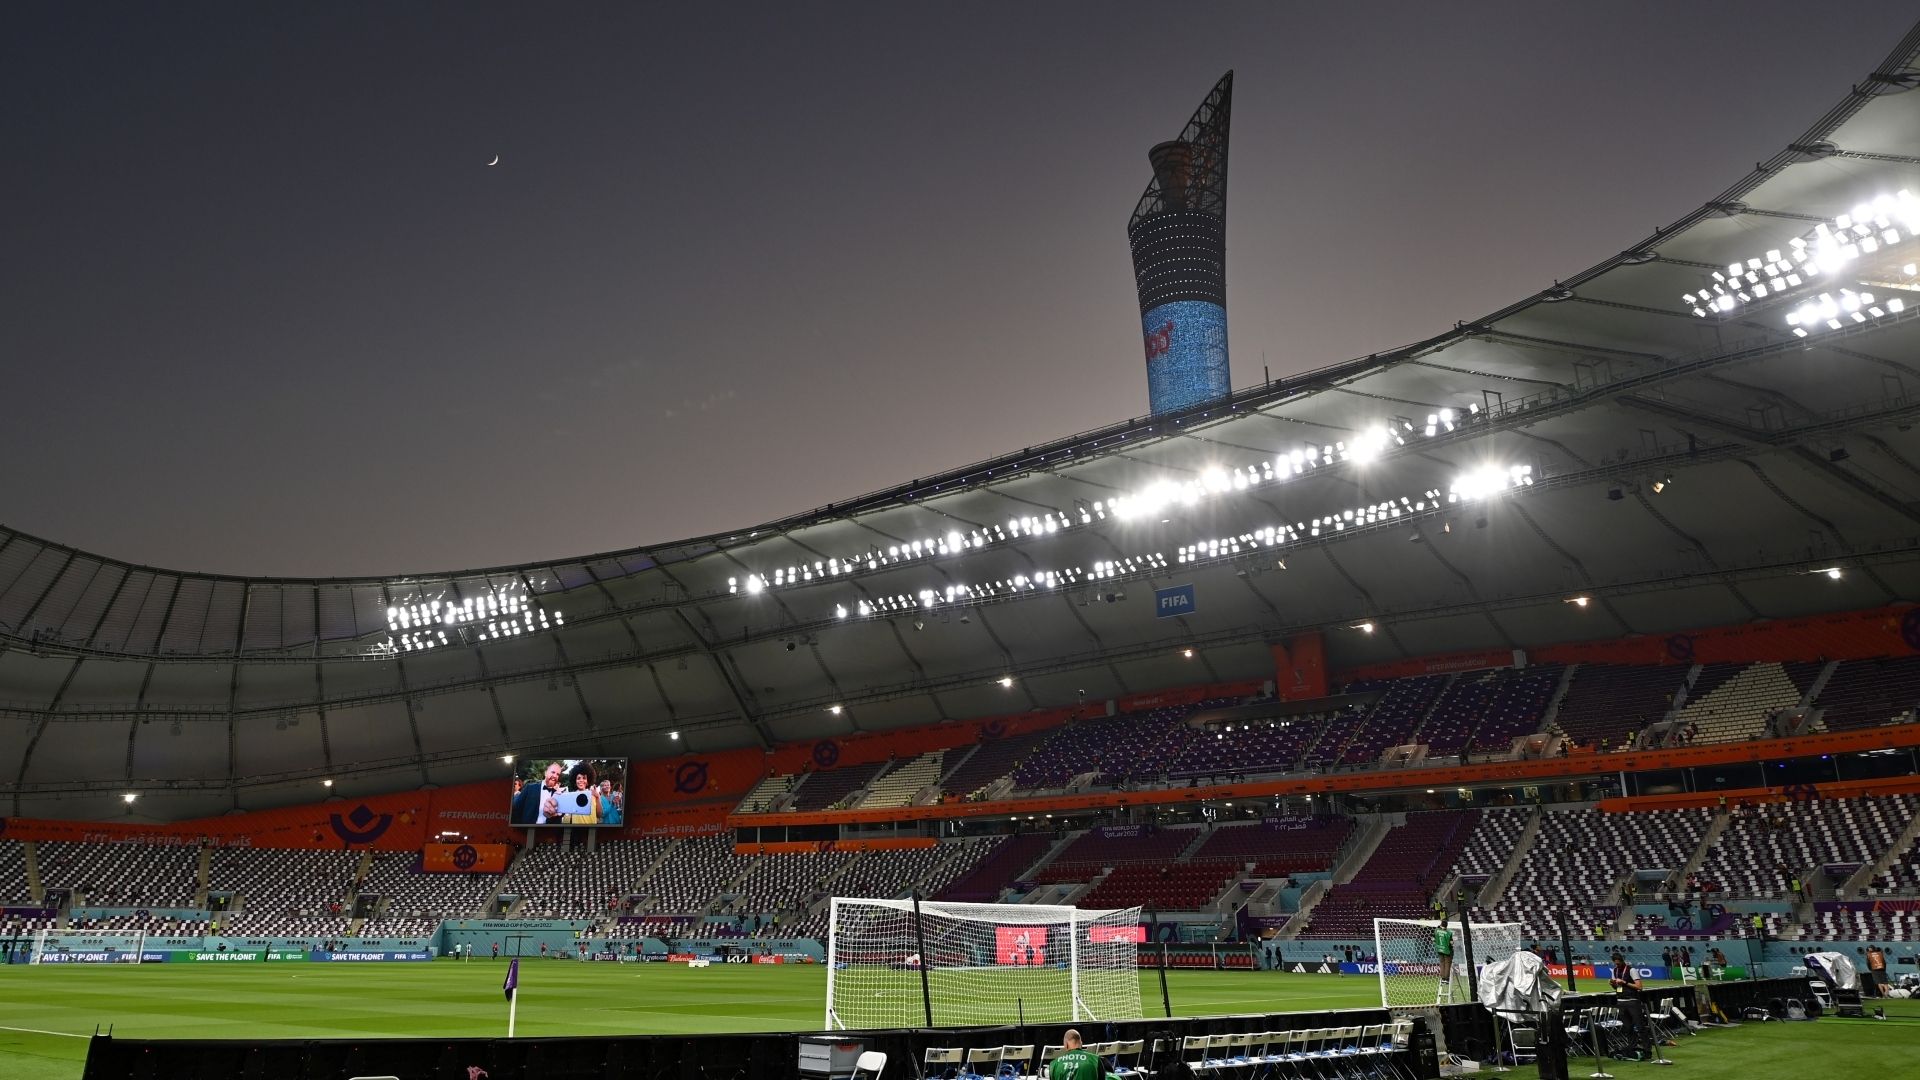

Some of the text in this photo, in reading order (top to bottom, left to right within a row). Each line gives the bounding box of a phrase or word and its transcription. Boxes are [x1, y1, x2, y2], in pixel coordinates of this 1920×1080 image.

[1161, 594, 1188, 608] FIFA
[156, 837, 182, 845] FIFA
[1356, 964, 1379, 973] VISA
[1058, 1054, 1087, 1062] PHOTO
